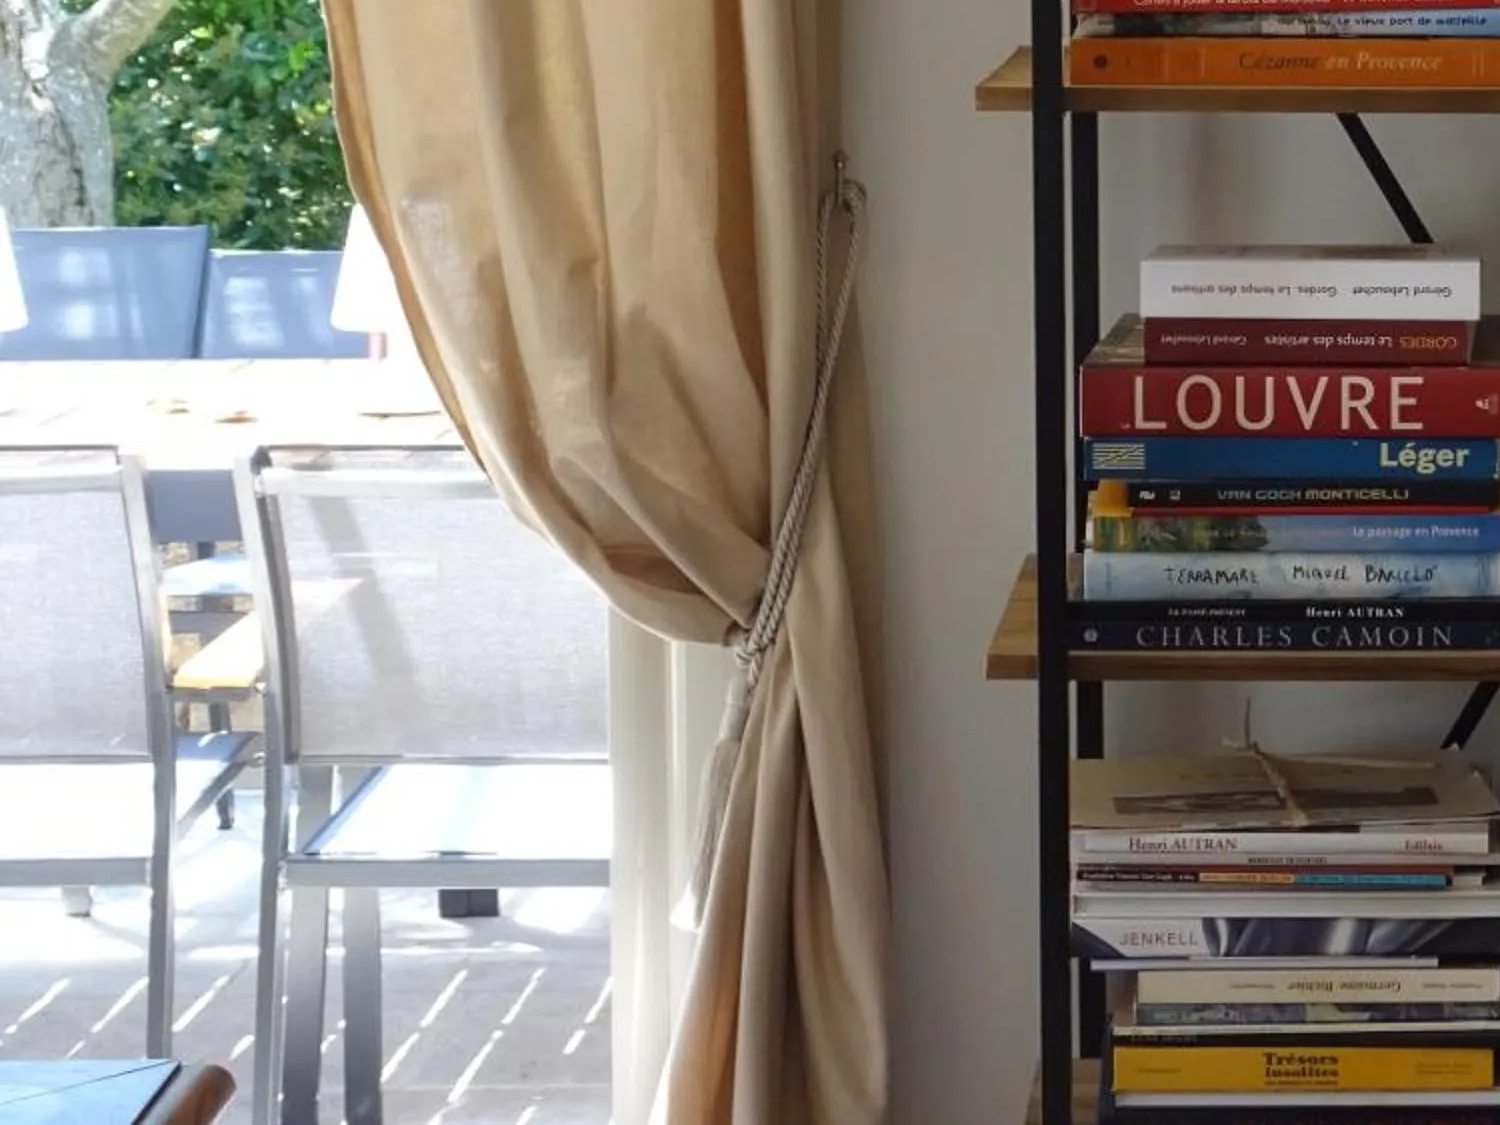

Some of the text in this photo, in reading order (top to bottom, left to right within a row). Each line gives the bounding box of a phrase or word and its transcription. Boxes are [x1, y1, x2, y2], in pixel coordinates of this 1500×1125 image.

[1389, 16, 1413, 28] port
[1418, 16, 1432, 26] de
[1325, 56, 1349, 70] en
[1356, 52, 1444, 71] Provence
[1218, 283, 1237, 296] des
[1239, 283, 1275, 296] temps
[1263, 333, 1309, 346] artistes
[1313, 334, 1335, 348] des
[1336, 333, 1373, 347] temps
[1375, 335, 1393, 347] Le
[1399, 336, 1457, 350] GORDES
[1133, 375, 1426, 431] LOUVRE
[1379, 441, 1470, 474] Léger
[1217, 488, 1410, 501] VAN GOGH MONTICELLI
[1414, 527, 1429, 537] en
[1431, 526, 1480, 537] Provence
[1305, 606, 1405, 618] Henri AUTRAN
[1135, 625, 1453, 648] CHARLES CAMOIN
[1128, 836, 1168, 852] Henri
[1171, 837, 1238, 850] AUTRAN
[1118, 931, 1199, 947] JENKELL
[1263, 1051, 1339, 1066] Trésors
